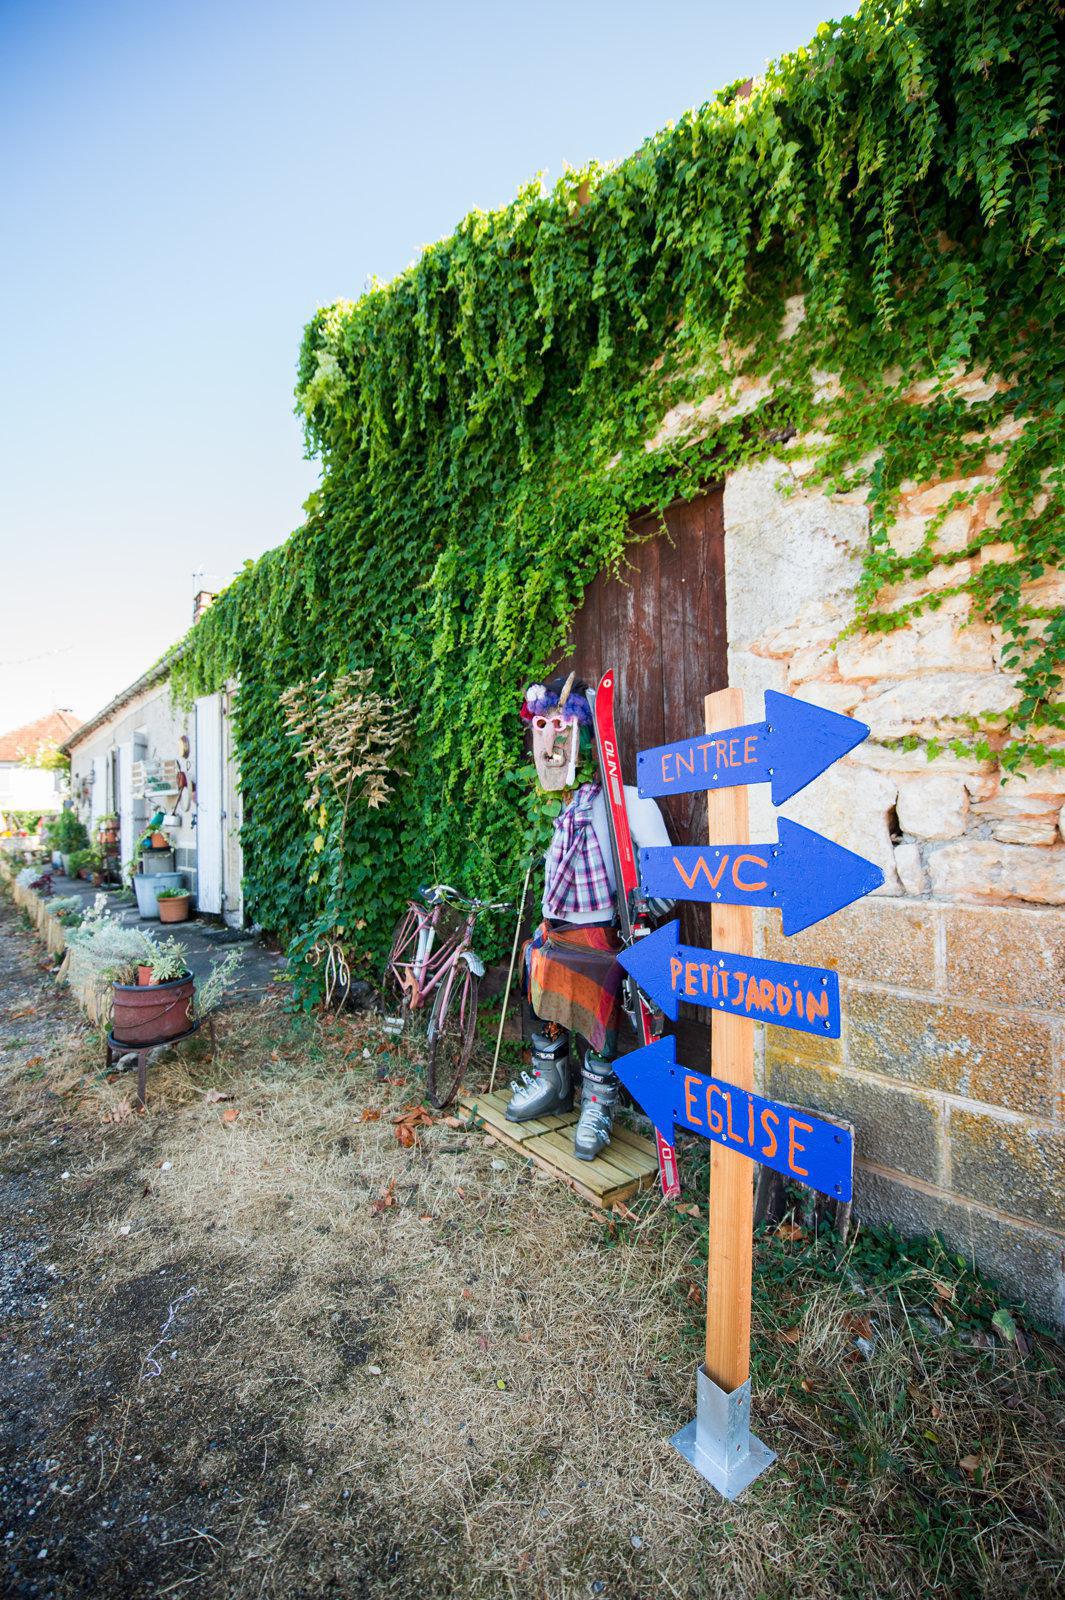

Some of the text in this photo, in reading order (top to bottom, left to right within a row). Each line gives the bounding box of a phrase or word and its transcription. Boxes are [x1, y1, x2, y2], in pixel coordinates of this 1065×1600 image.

[604, 740, 618, 777] OLIN
[661, 735, 760, 783] ENTREE
[672, 854, 769, 892] WC
